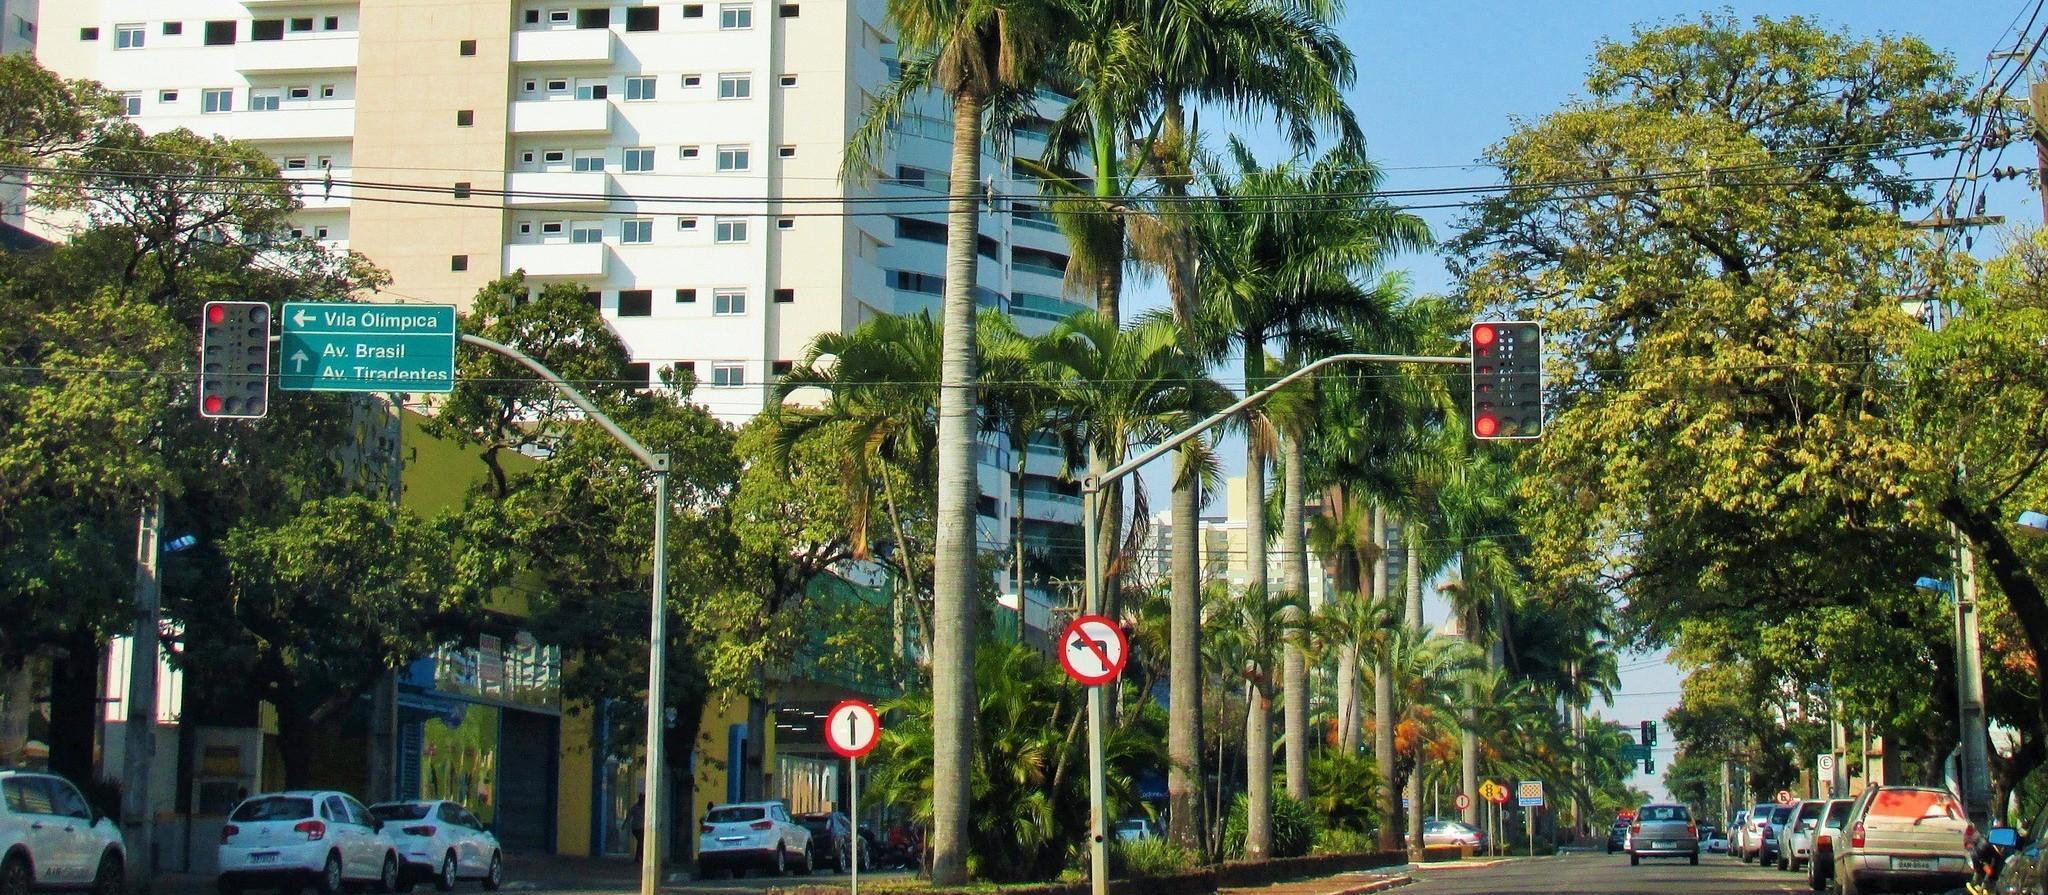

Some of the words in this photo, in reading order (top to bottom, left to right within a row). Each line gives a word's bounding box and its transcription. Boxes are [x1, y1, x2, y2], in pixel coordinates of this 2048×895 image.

[324, 312, 356, 327] Vila
[322, 343, 349, 358] Av.
[356, 343, 405, 358] Brasil
[321, 366, 348, 381] Av.
[353, 366, 448, 381] Tiradentes
